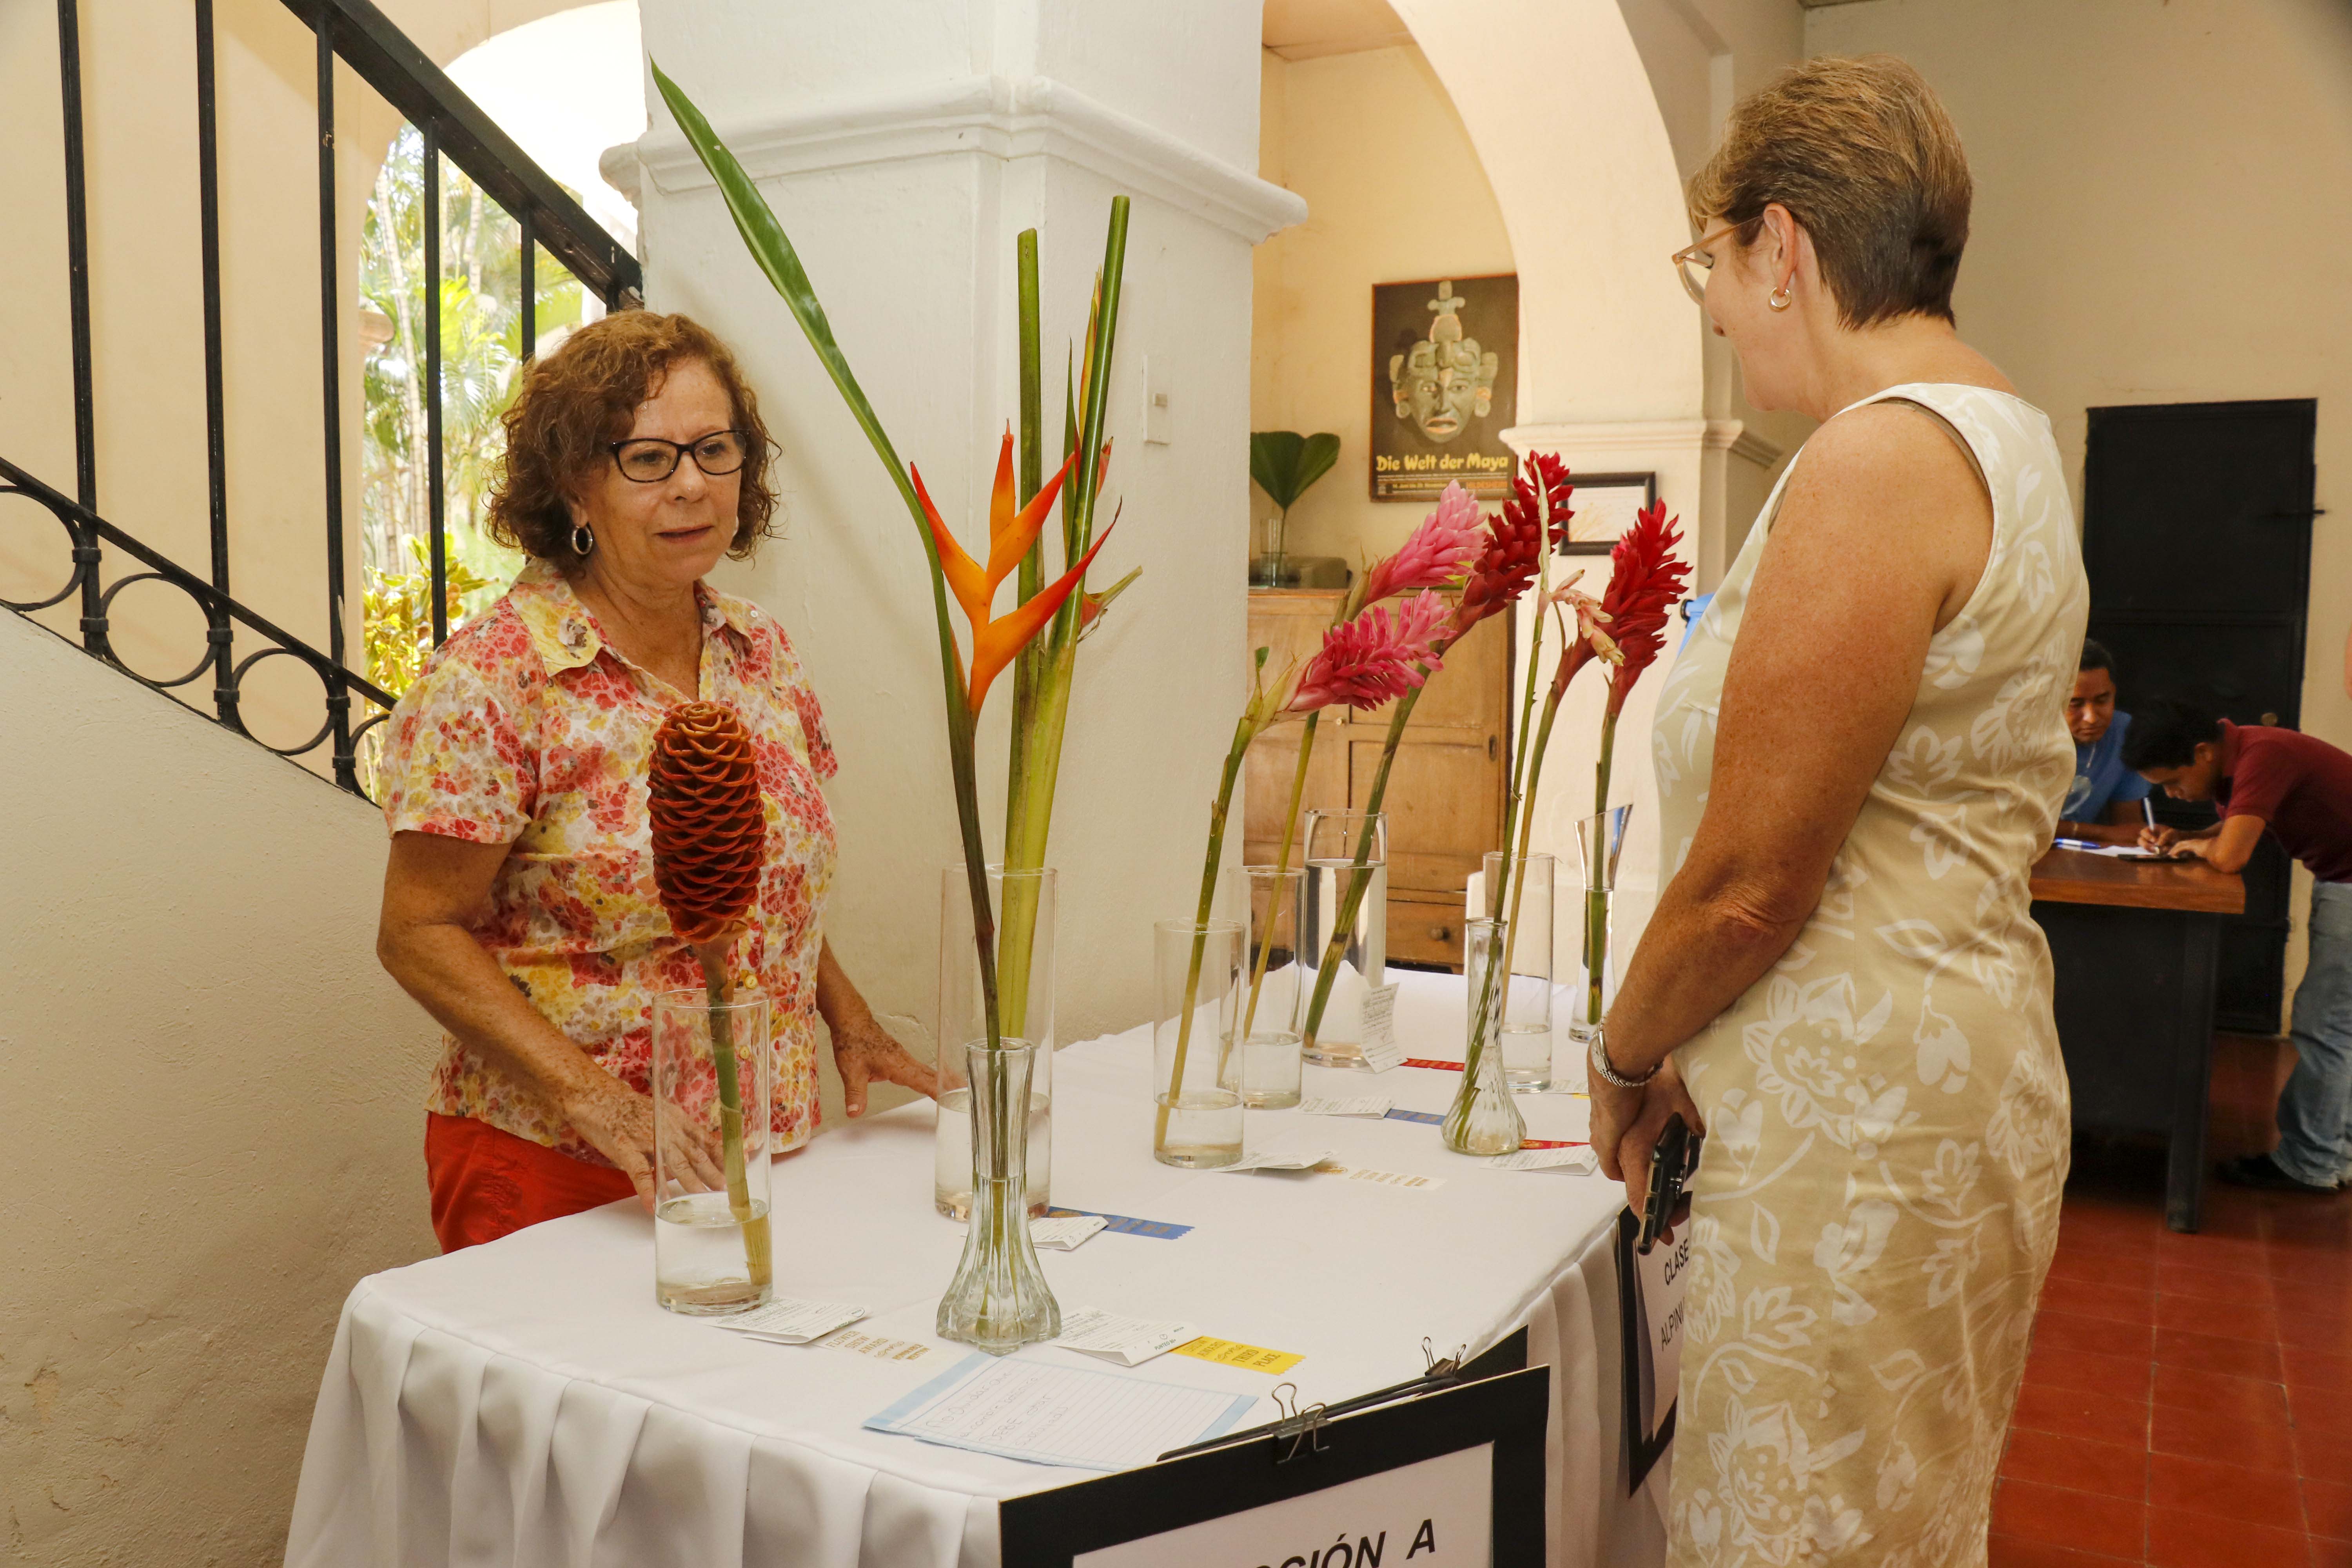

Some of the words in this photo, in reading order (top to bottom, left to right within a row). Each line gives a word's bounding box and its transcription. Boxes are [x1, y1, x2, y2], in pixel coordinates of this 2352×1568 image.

[1376, 455, 1400, 472] Die
[1404, 454, 1437, 470] Welt
[1439, 454, 1465, 470] der
[1466, 452, 1509, 472] Maya
[1665, 1238, 1689, 1286] CLASE
[1661, 1296, 1685, 1352] ALPINI
[825, 1330, 860, 1347] FLOWER
[844, 1336, 869, 1348] SHOW
[858, 1338, 888, 1354] AWARD
[1154, 1341, 1170, 1350] PUNTEO
[1232, 1349, 1259, 1362] THIRD
[1252, 1353, 1281, 1367] PLACE
[978, 1417, 1023, 1443] DEBE
[1405, 1518, 1436, 1560] A
